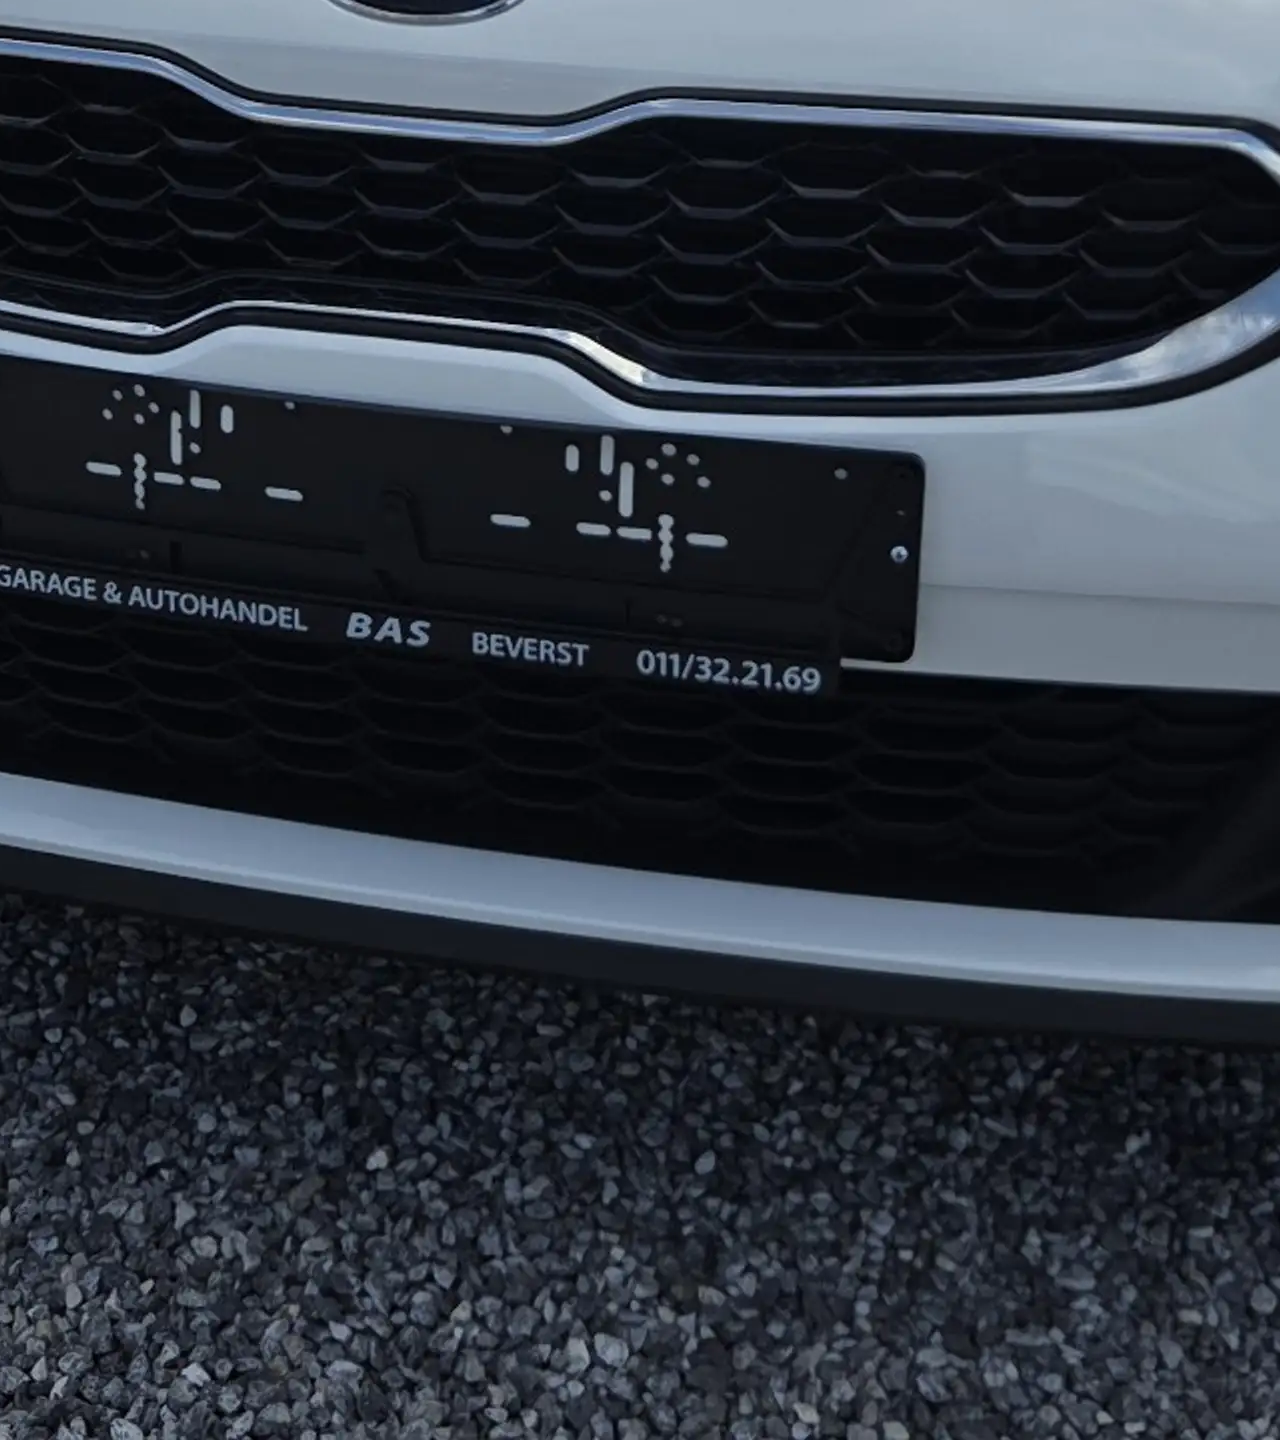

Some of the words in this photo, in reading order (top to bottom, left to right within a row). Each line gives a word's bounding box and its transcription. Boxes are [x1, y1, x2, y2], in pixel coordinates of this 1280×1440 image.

[103, 581, 122, 605] &
[128, 585, 309, 632] AUTOHANDEL
[345, 611, 432, 649] BAS
[471, 630, 590, 667] BEVERST
[636, 648, 822, 693] 011/32.21.69
